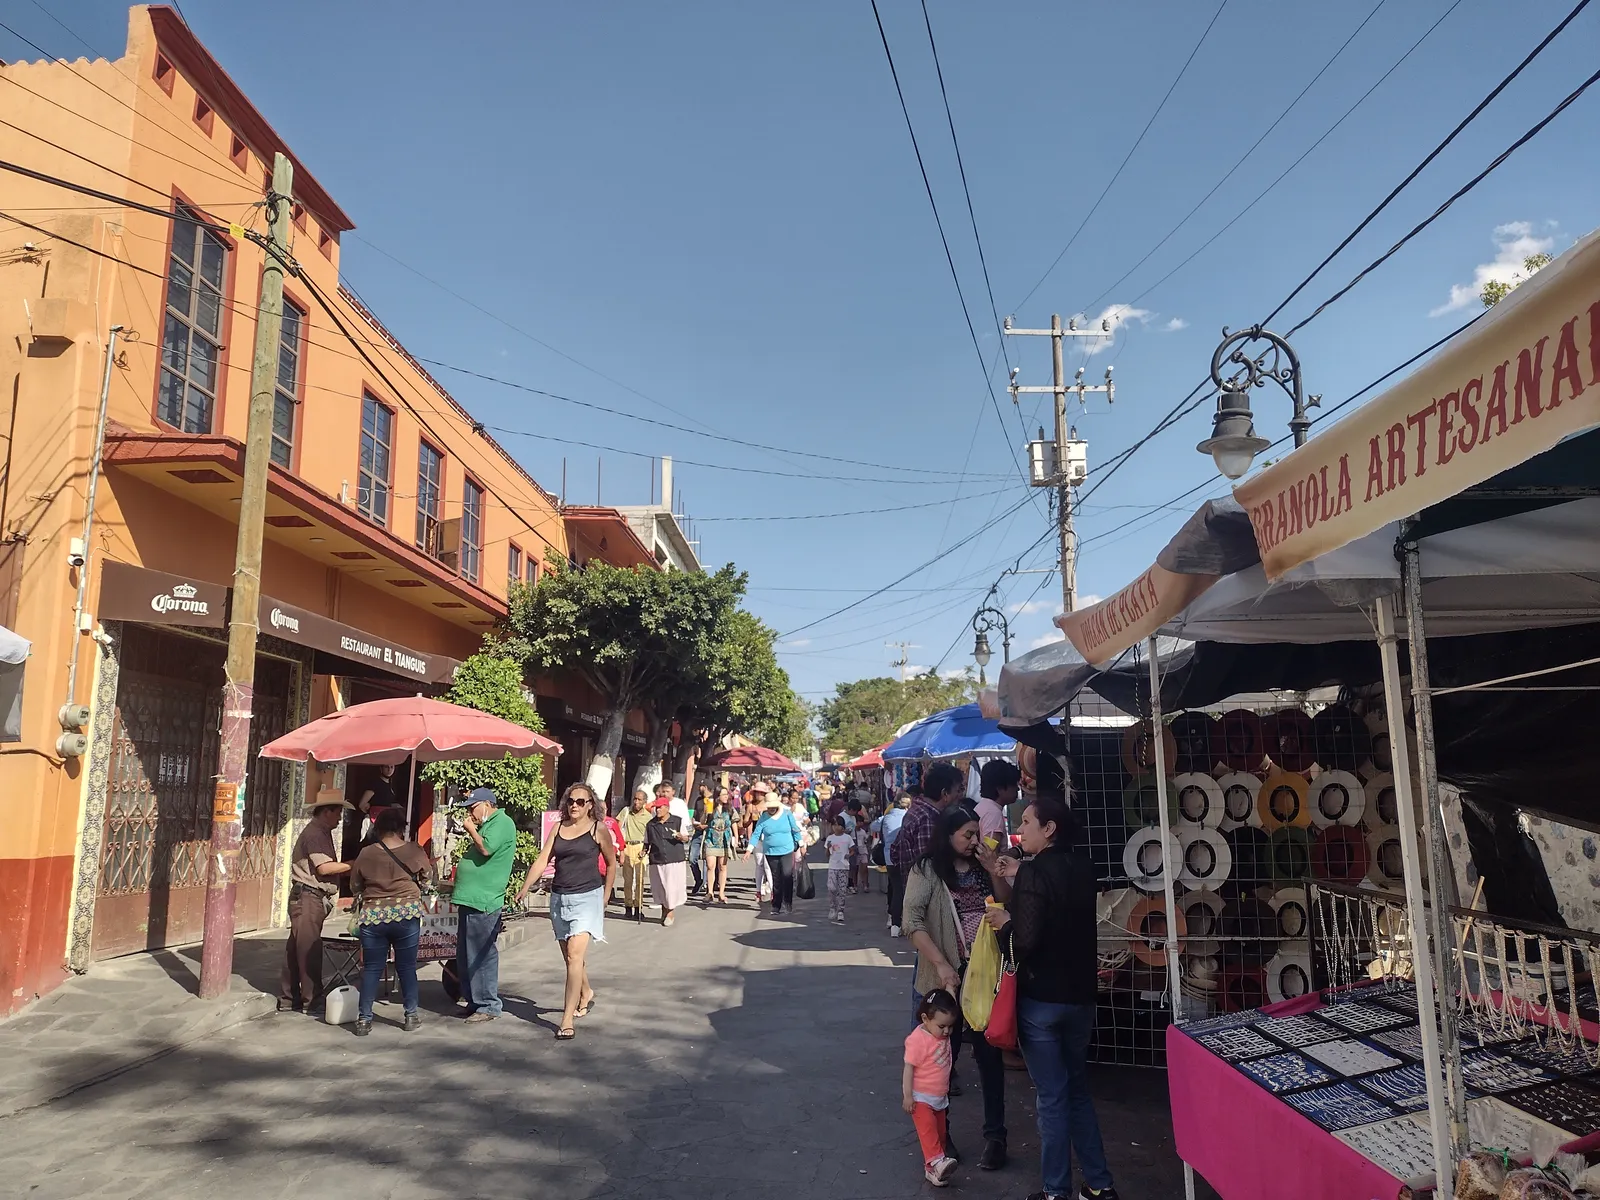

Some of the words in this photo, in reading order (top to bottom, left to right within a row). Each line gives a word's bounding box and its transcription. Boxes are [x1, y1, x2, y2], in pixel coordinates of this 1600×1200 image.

[151, 594, 209, 614] Corona
[1106, 598, 1123, 635] DE
[1118, 568, 1160, 628] PLATA
[270, 607, 299, 631] Corona
[341, 636, 382, 659] RESTAURANT
[383, 647, 393, 664] EL
[394, 650, 426, 674] TIANGUIS
[431, 917, 457, 927] PUR
